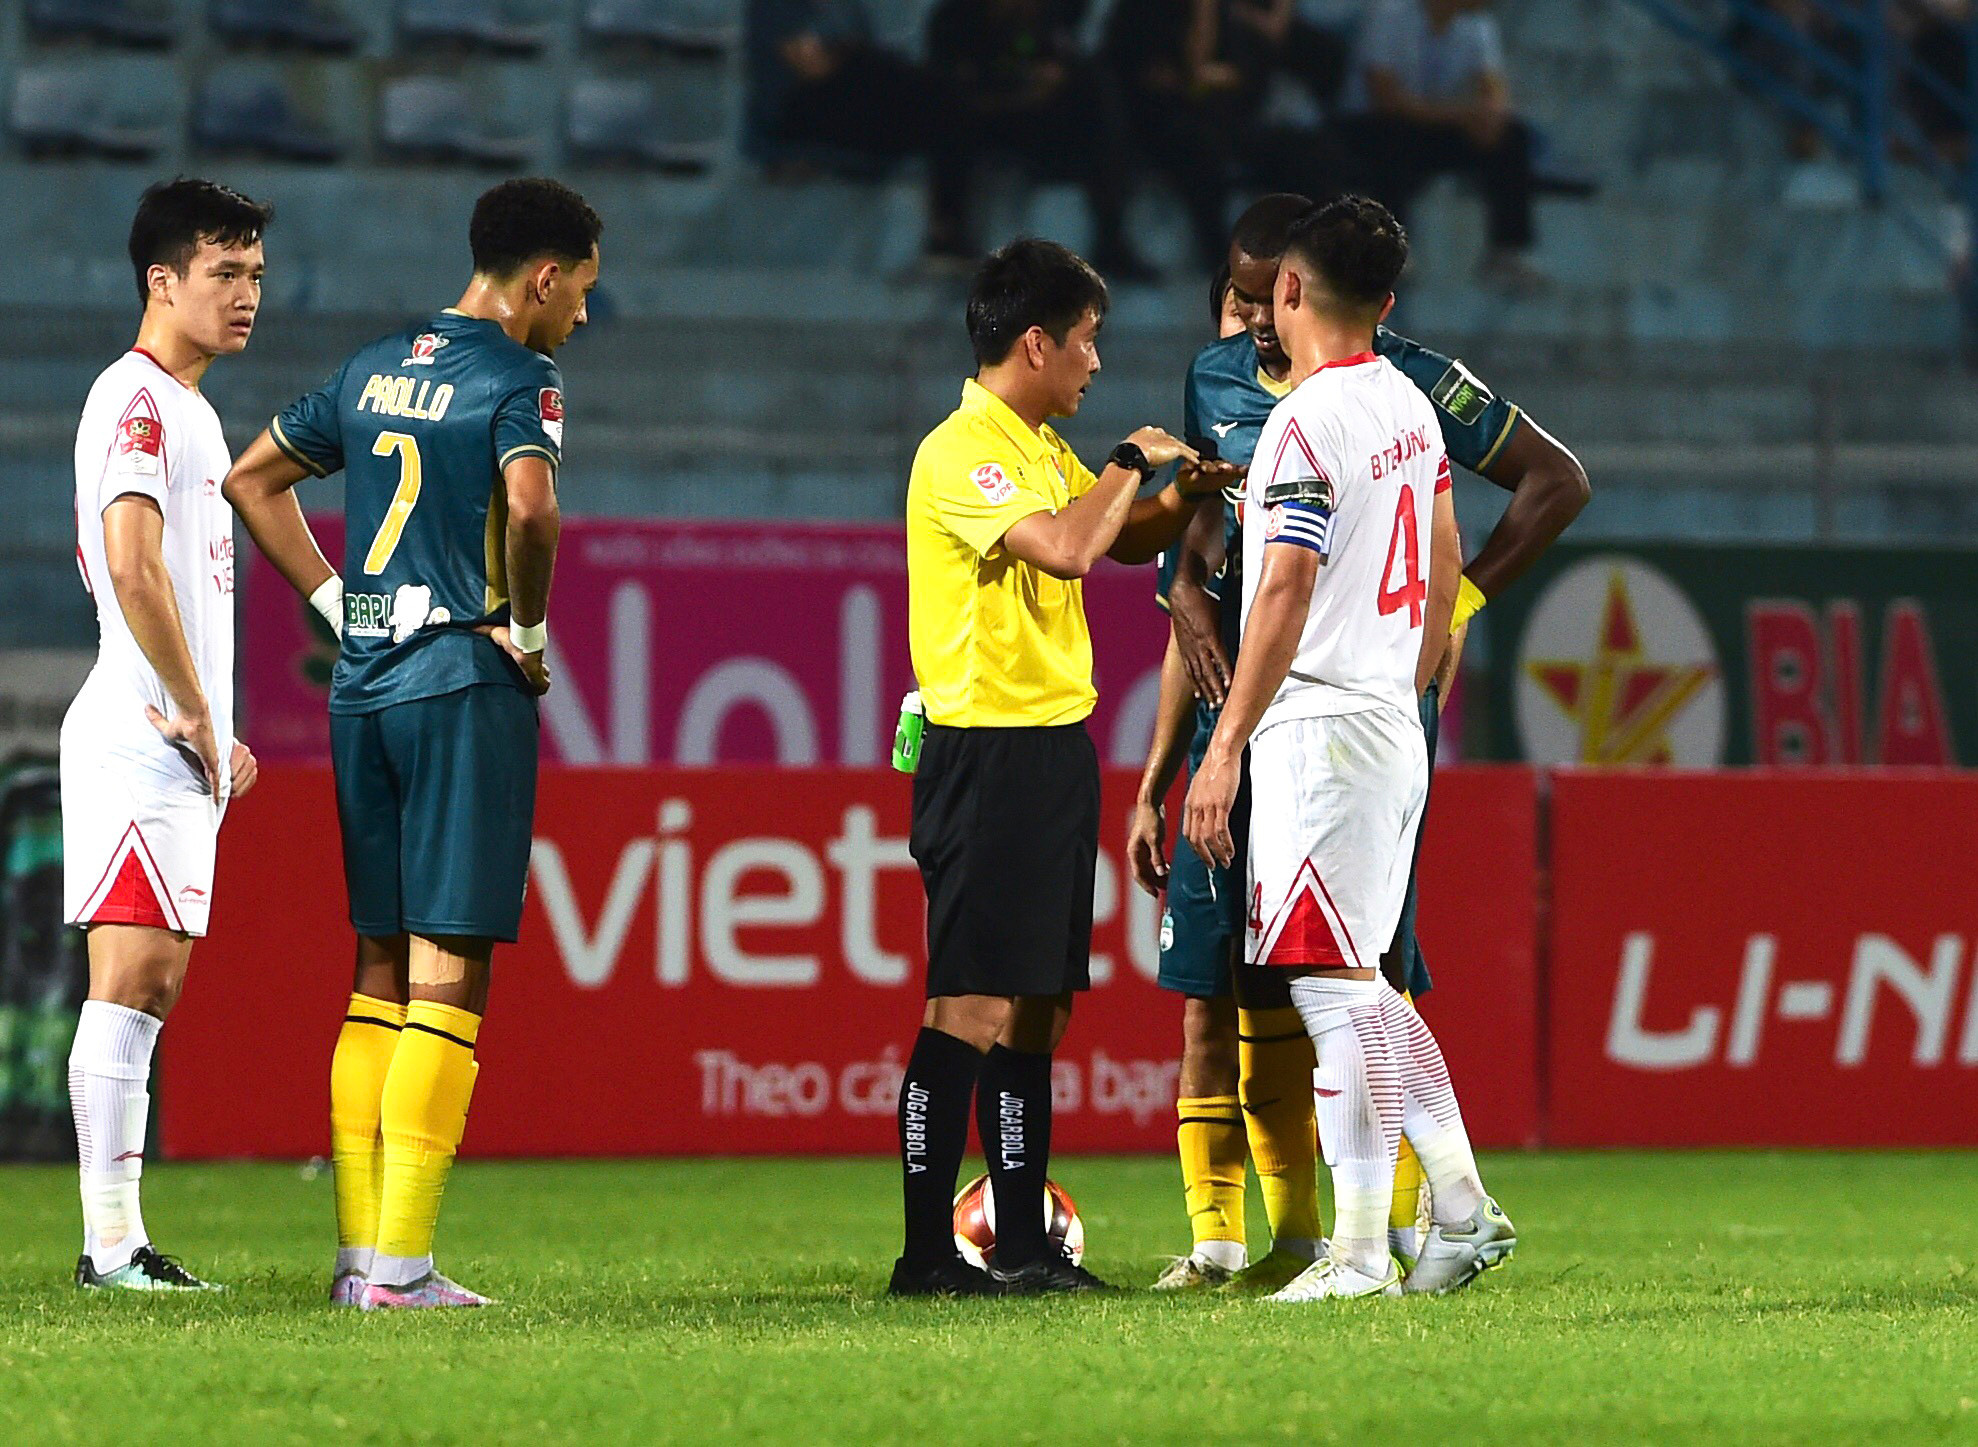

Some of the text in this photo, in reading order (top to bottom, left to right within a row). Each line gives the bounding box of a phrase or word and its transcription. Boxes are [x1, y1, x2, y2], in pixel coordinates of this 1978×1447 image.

[357, 374, 455, 422] PAOLLO
[364, 430, 422, 575] 7
[991, 482, 1013, 502] VPF
[1377, 483, 1426, 630] 4
[345, 593, 392, 628] BAPI
[1745, 597, 1956, 766] BIA
[694, 1049, 832, 1116] Theo
[906, 1081, 930, 1174] JOGARBOLA
[1000, 1091, 1026, 1171] JOGARBOLA
